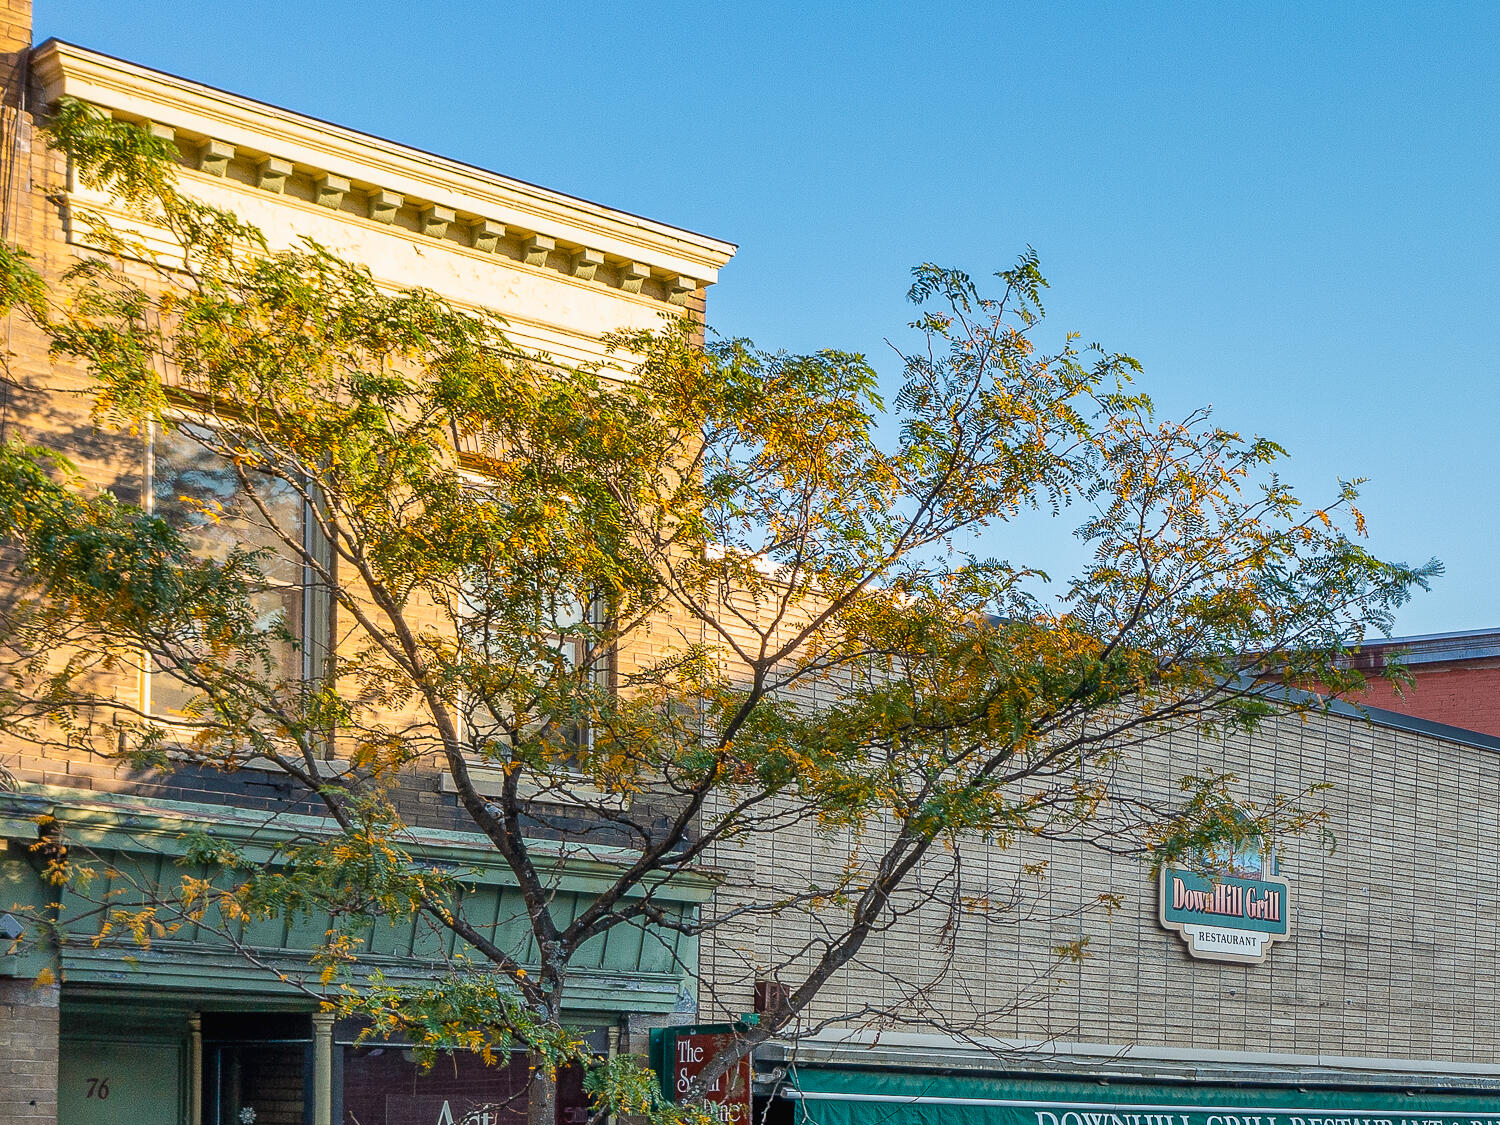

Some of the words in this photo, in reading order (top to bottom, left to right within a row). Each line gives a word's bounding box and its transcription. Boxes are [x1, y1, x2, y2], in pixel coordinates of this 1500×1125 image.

[1245, 886, 1281, 921] Grill
[1199, 931, 1257, 947] RESTAURANT
[677, 1040, 704, 1063] The
[87, 1077, 109, 1100] 76
